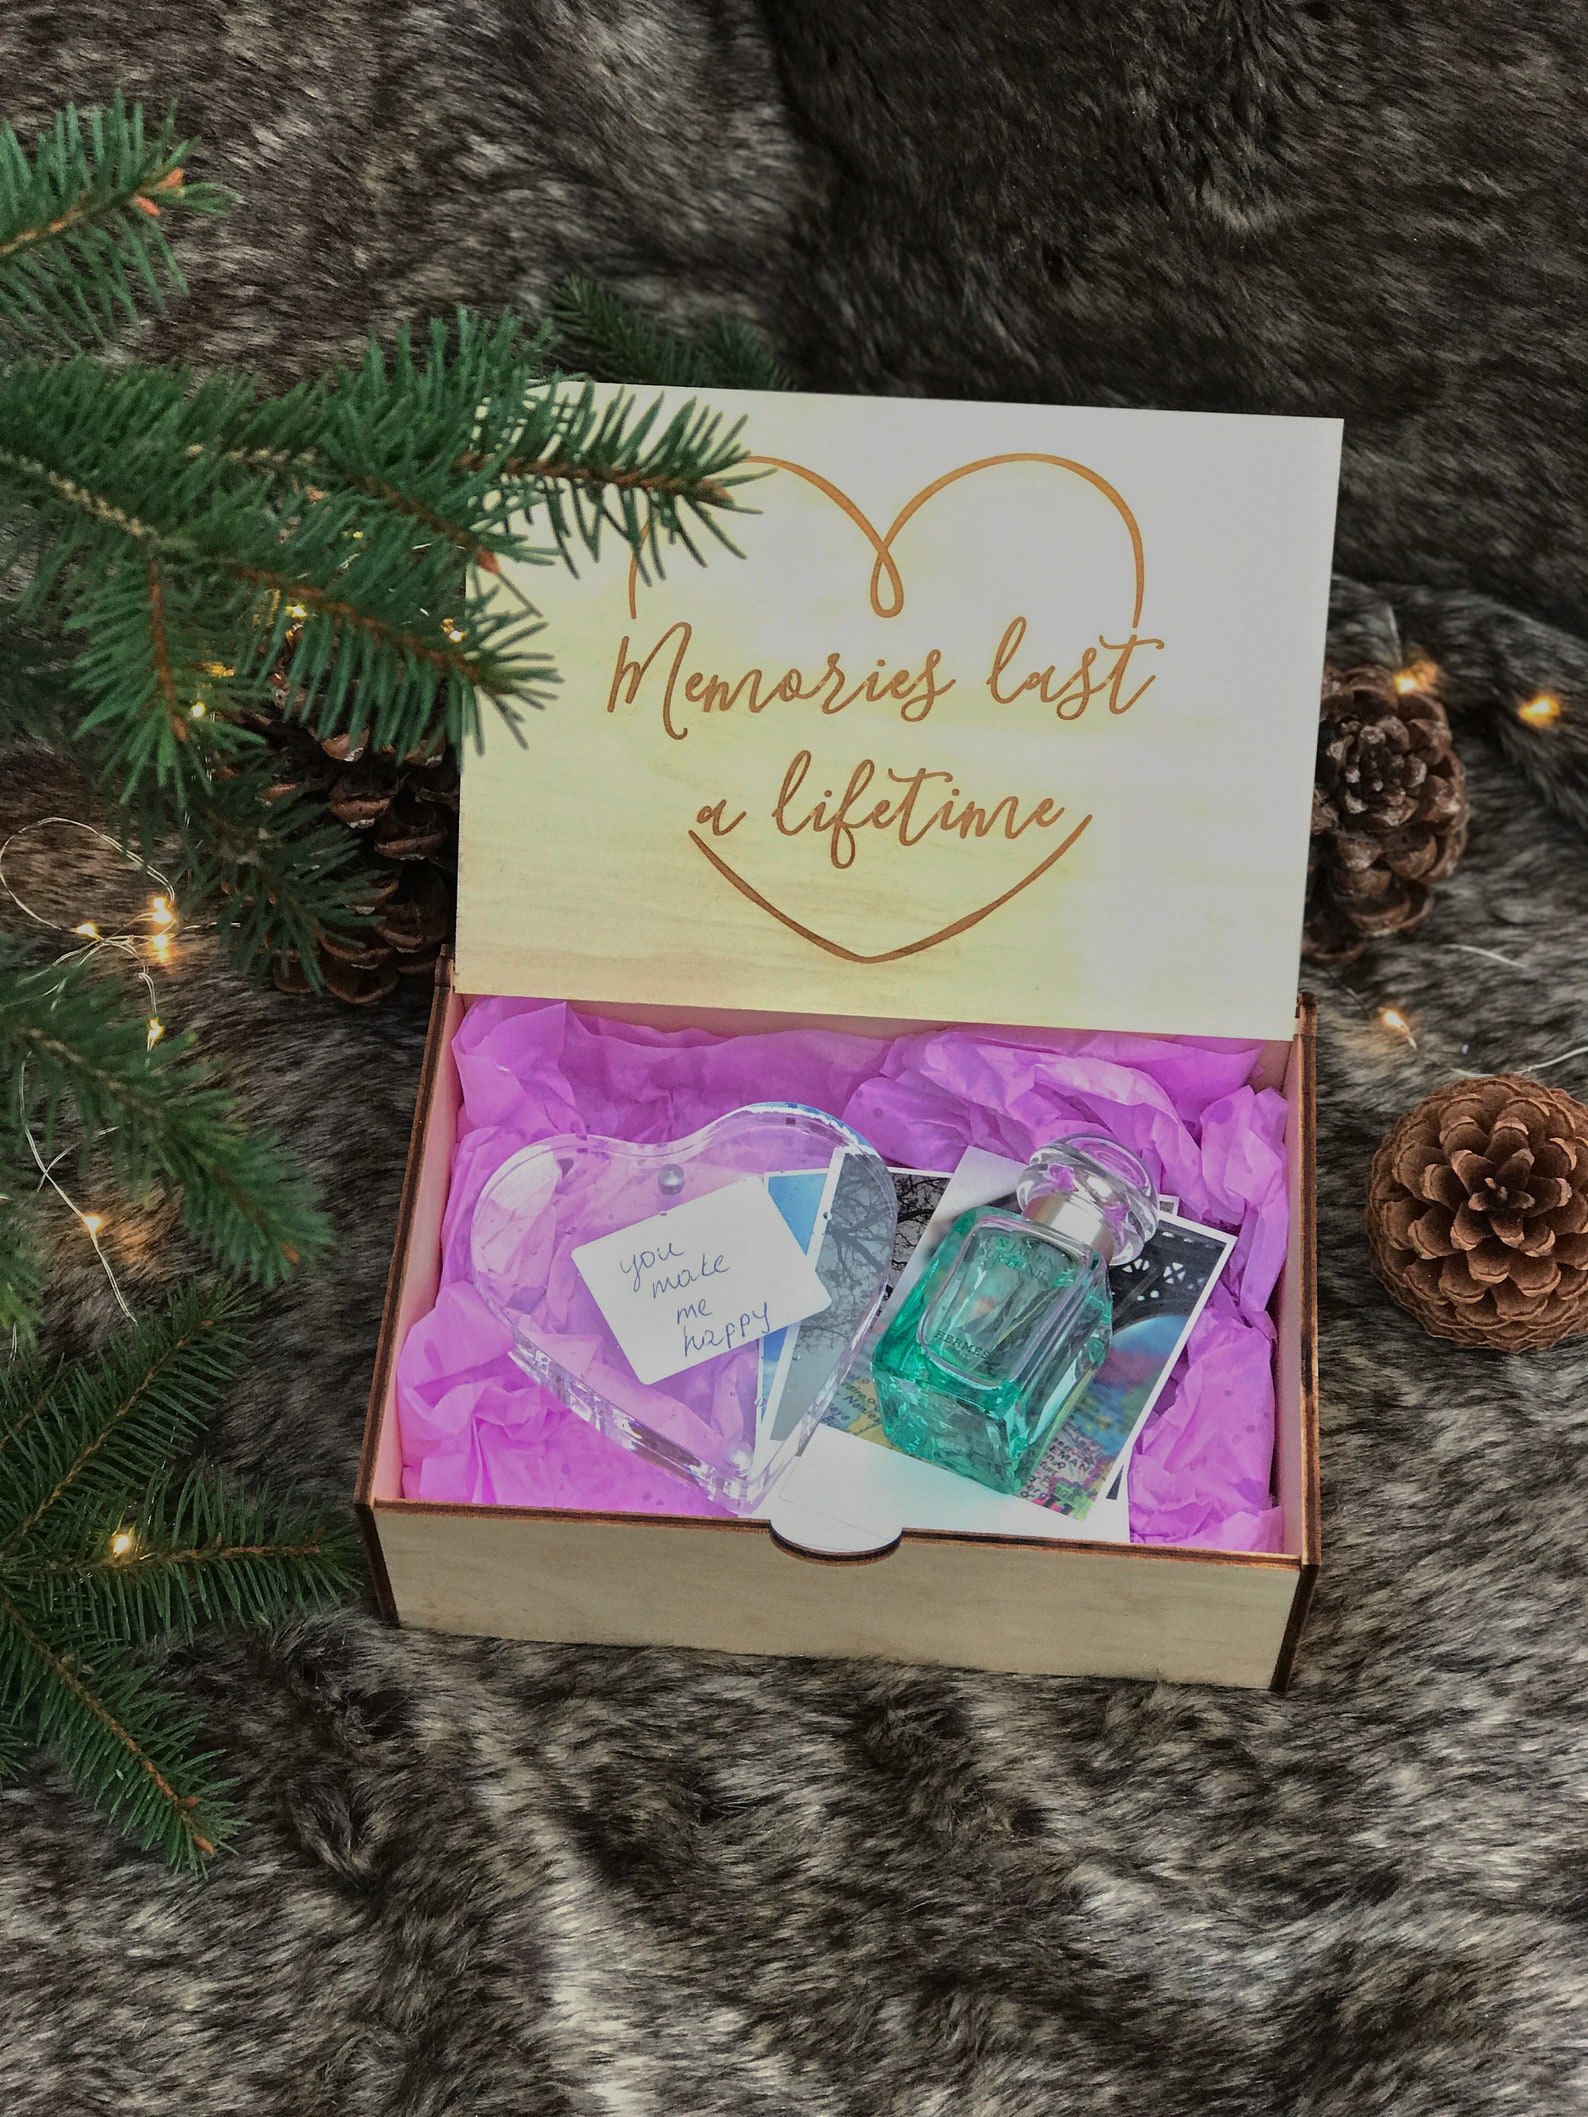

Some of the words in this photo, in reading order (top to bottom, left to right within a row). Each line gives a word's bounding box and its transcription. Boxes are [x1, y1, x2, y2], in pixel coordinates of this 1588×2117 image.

[606, 621, 957, 741] Memories
[985, 616, 1166, 721] last
[695, 798, 748, 837] a
[770, 749, 1066, 870] lifetime
[619, 1242, 686, 1293] you
[676, 1298, 713, 1325] me
[683, 1301, 771, 1358] happy
